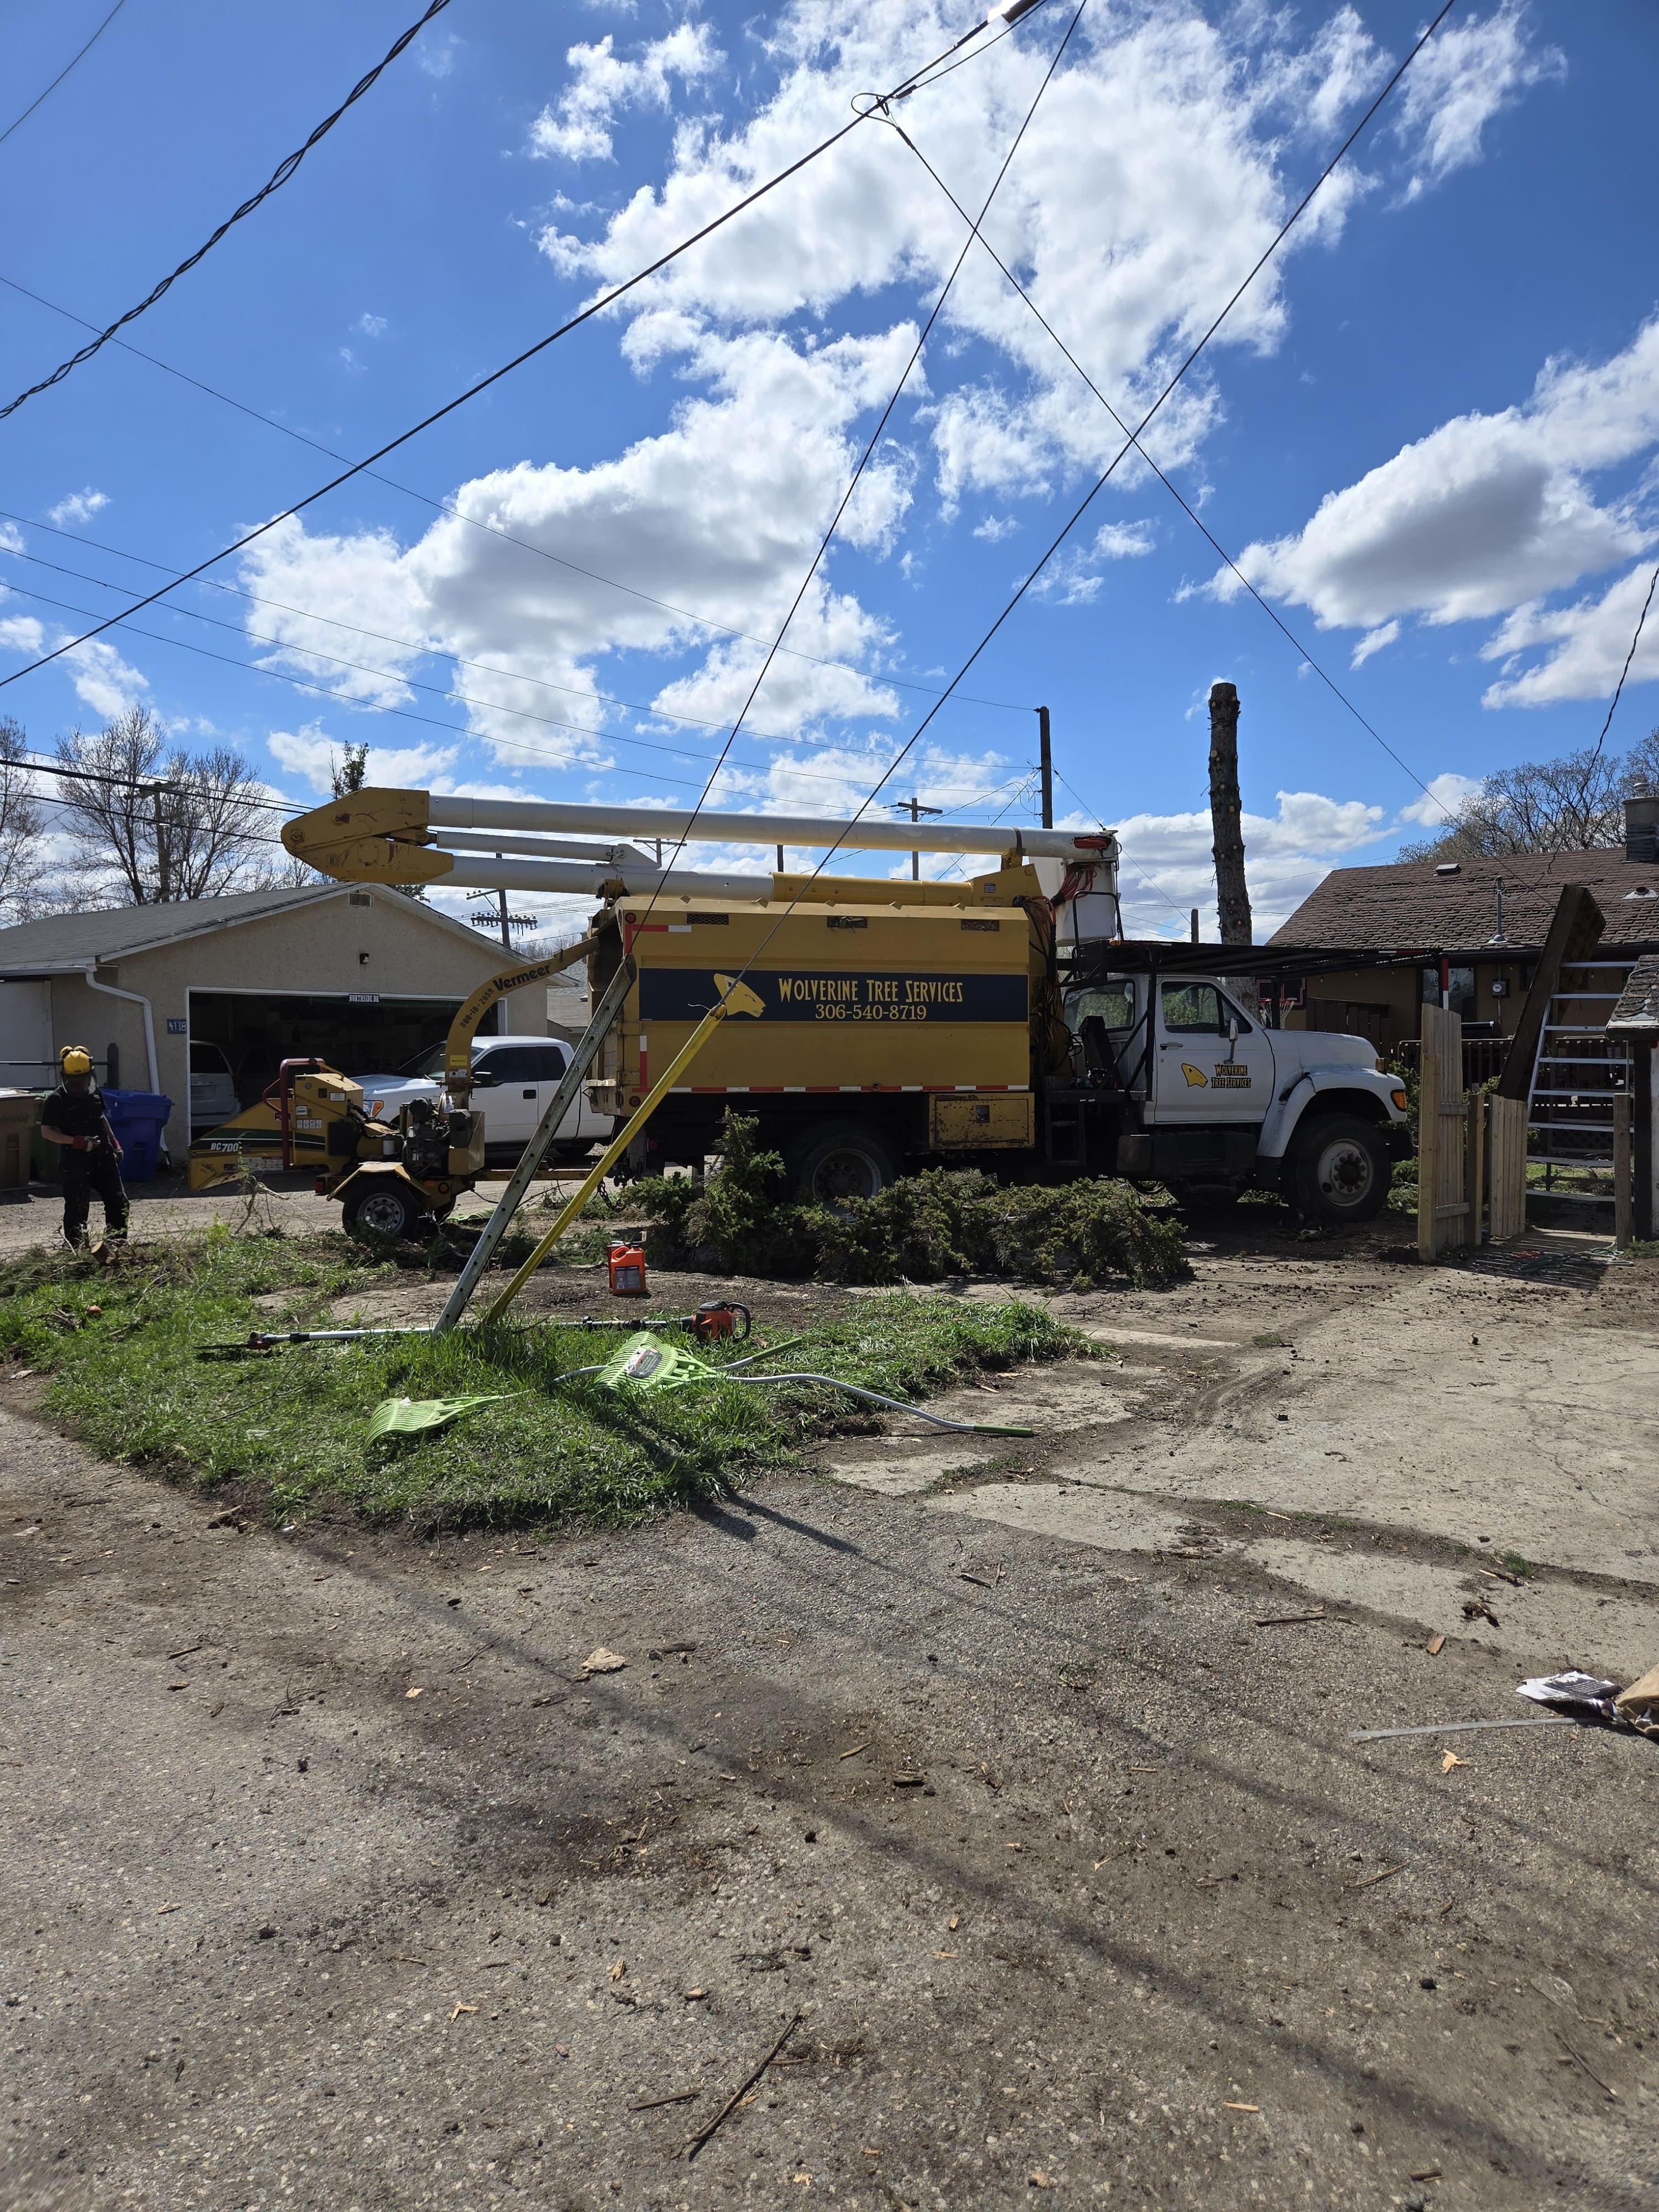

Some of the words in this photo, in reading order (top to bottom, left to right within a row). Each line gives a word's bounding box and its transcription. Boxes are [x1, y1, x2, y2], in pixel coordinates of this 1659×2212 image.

[493, 964, 550, 992] Vermeer
[778, 978, 858, 1003] WOLVERINE
[866, 979, 899, 1002] TREE
[905, 980, 963, 1003] SERVICES
[815, 1004, 927, 1020] 306-540-8719
[169, 1021, 186, 1031] 4118
[1215, 1065, 1248, 1077] WOLVERINE
[1211, 1078, 1225, 1088] TREE
[1227, 1078, 1251, 1088] SERVICES
